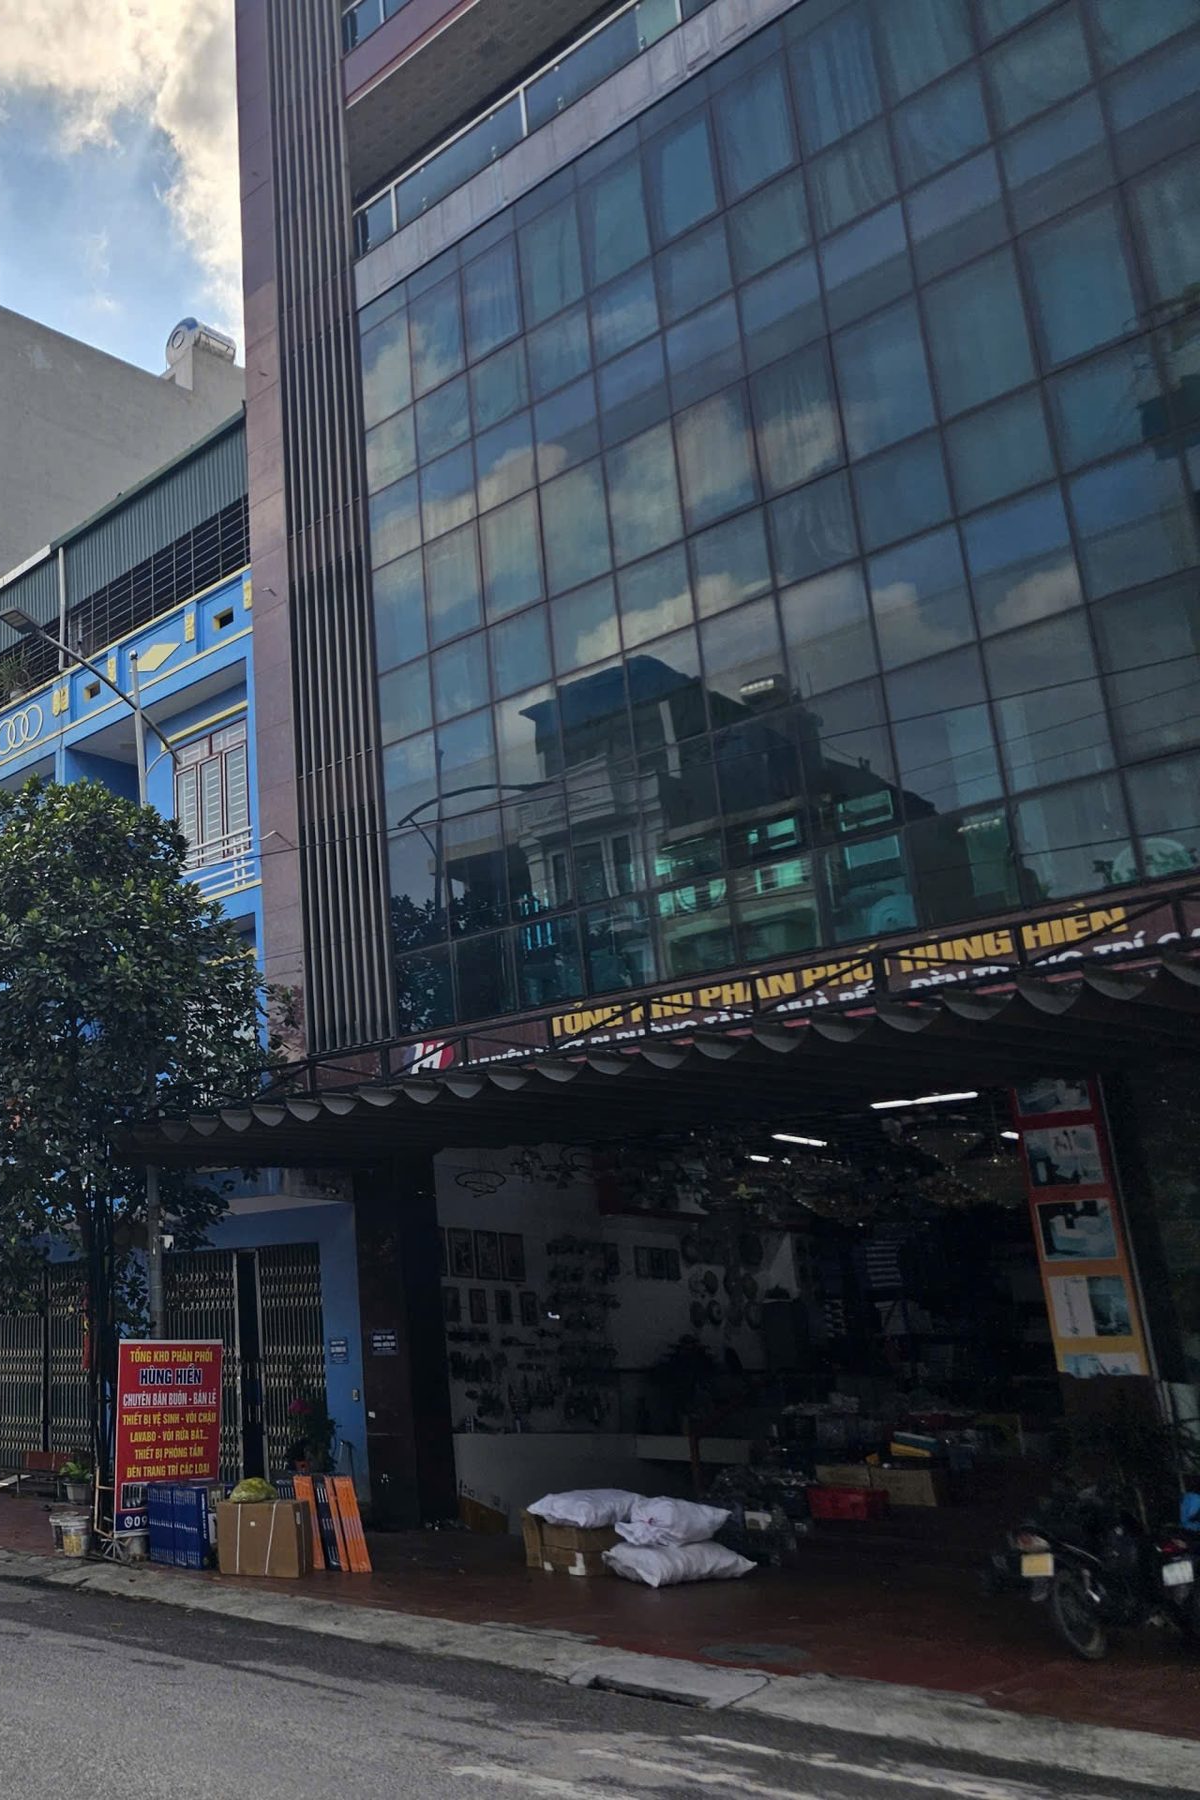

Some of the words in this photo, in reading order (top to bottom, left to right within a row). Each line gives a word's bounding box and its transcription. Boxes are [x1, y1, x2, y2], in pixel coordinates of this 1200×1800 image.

[552, 1001, 624, 1037] TỔNG
[698, 970, 796, 1008] PHÂN
[130, 1346, 151, 1362] TỔNG
[153, 1351, 170, 1362] KHO
[171, 1349, 193, 1362] PHÂN
[194, 1346, 213, 1362] PHỐI
[139, 1365, 173, 1386] HÙNG
[123, 1391, 151, 1406] CHUYÊN
[152, 1390, 168, 1406] BÁN
[122, 1411, 142, 1425] THIẾT
[163, 1413, 180, 1424] SINH
[130, 1431, 156, 1442] LAVABO
[135, 1445, 154, 1460] THIẾT
[143, 1465, 166, 1477] TRANG
